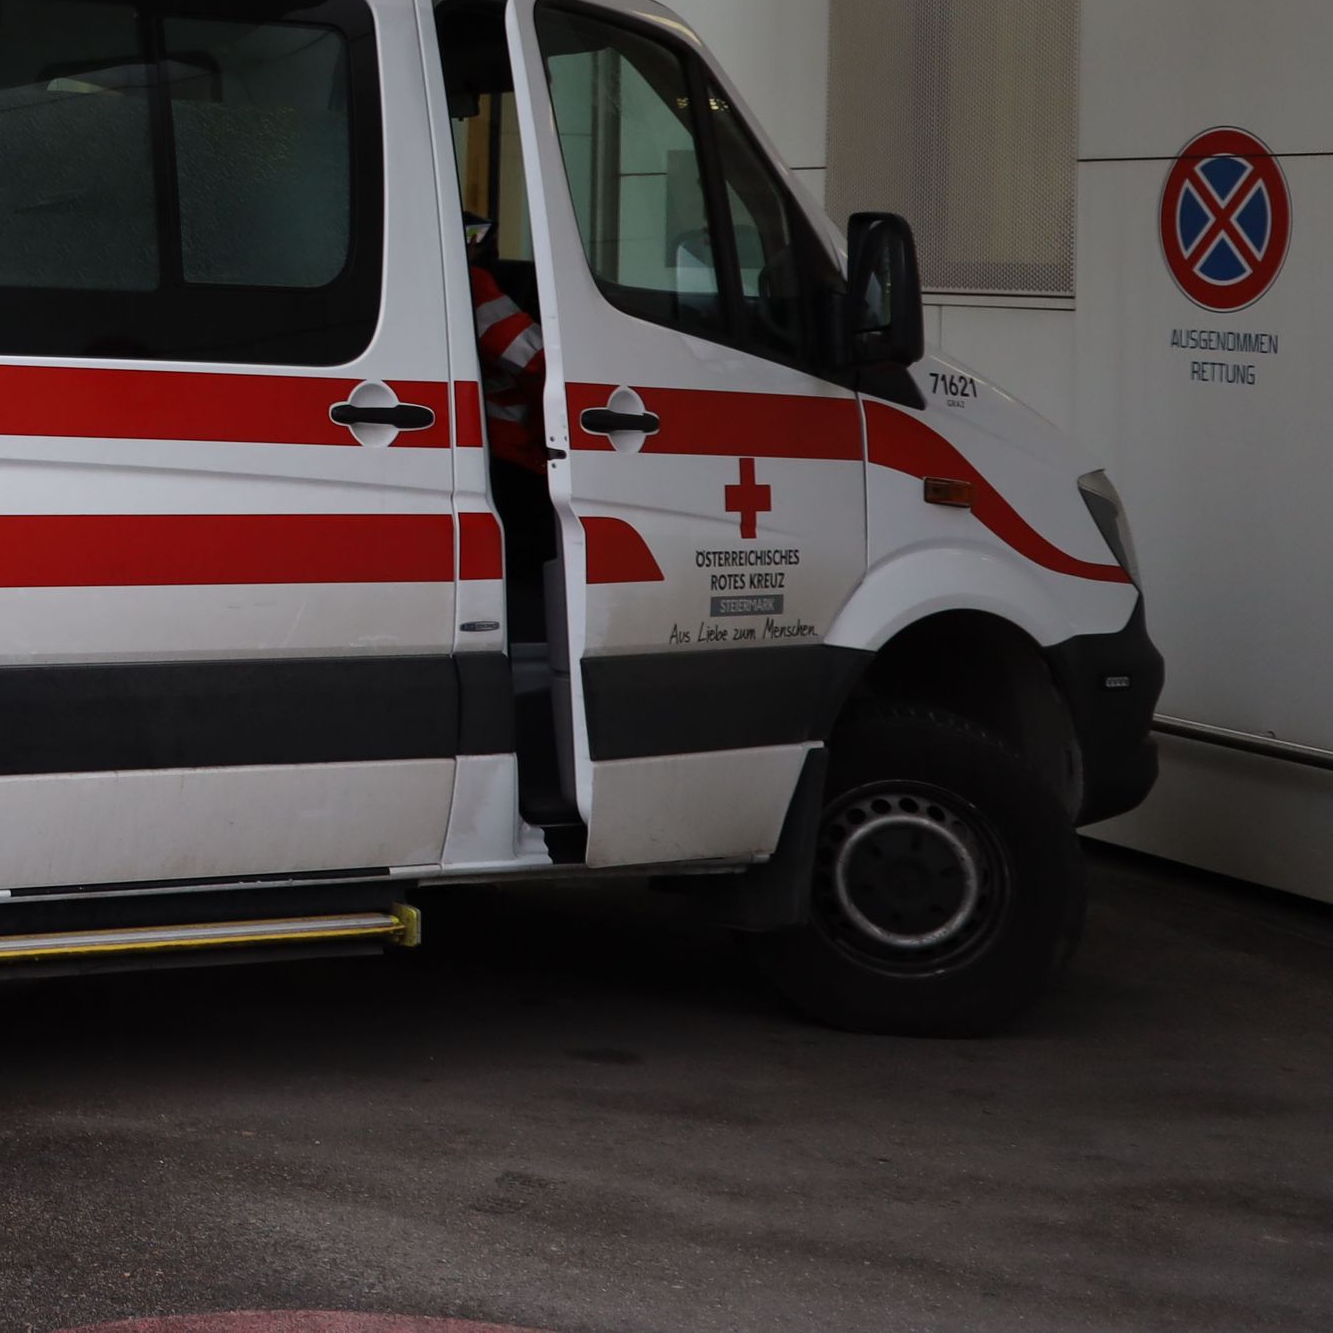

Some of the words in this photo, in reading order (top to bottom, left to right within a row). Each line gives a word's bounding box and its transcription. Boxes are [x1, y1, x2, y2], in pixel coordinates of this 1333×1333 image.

[1170, 328, 1279, 355] AUSGENOMMEN
[929, 372, 977, 398] 71621
[1190, 361, 1256, 386] RETTUNG
[695, 549, 800, 567] ÖSTERREICHISCHES
[710, 573, 746, 590] ROTES
[749, 572, 785, 589] KREUZ
[719, 597, 775, 614] STEIERMARK
[669, 623, 691, 645] Aus
[697, 621, 728, 643] Liebe
[733, 627, 756, 642] zum
